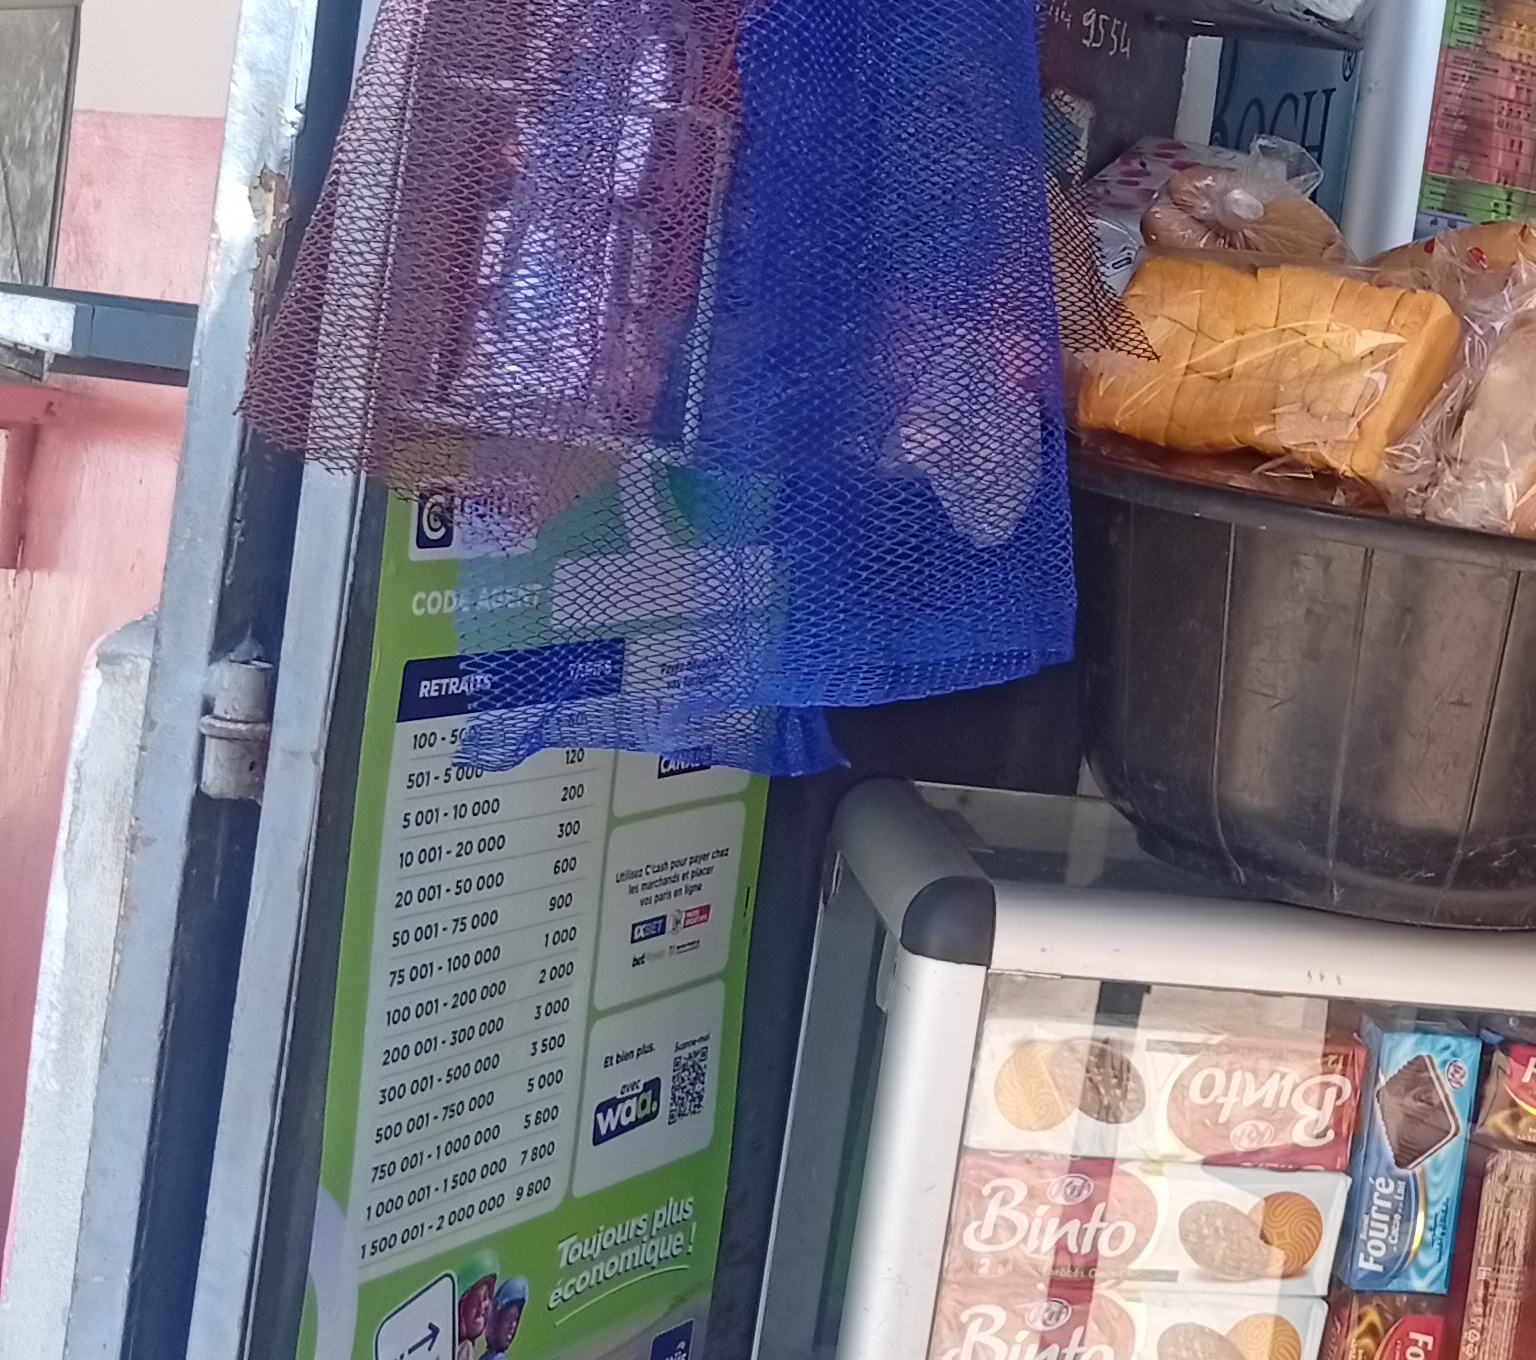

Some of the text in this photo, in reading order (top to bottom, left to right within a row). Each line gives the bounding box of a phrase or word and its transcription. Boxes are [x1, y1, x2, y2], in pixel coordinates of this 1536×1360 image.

[1081, 8, 1131, 59] 9554
[419, 673, 493, 698] RETRAITS
[407, 747, 584, 789] 501 5 000 120
[413, 732, 437, 750] 100
[402, 784, 584, 829] 5 001 10 000 200
[400, 820, 580, 868] 10 001 20 000 300
[395, 856, 577, 909] 20 001 50 000 600
[392, 893, 572, 947] 50 001 75 000 900
[386, 961, 574, 1026] 100 001 200 000 2 000
[379, 1034, 565, 1105] 300 001 500 000 3 500
[604, 1055, 614, 1068] Et
[616, 1050, 634, 1064] bien
[620, 1079, 641, 1095] avec
[1187, 1066, 1353, 1148] Binto
[367, 1141, 555, 1221] 1 000 001 1 500 000 7 800
[362, 1176, 551, 1259] 1 500 001 2 000 000 9 800
[558, 1196, 694, 1268] Toujours plus
[963, 1177, 1137, 1259] Binto
[1359, 1176, 1395, 1273] Fourré
[548, 1231, 684, 1309] économique
